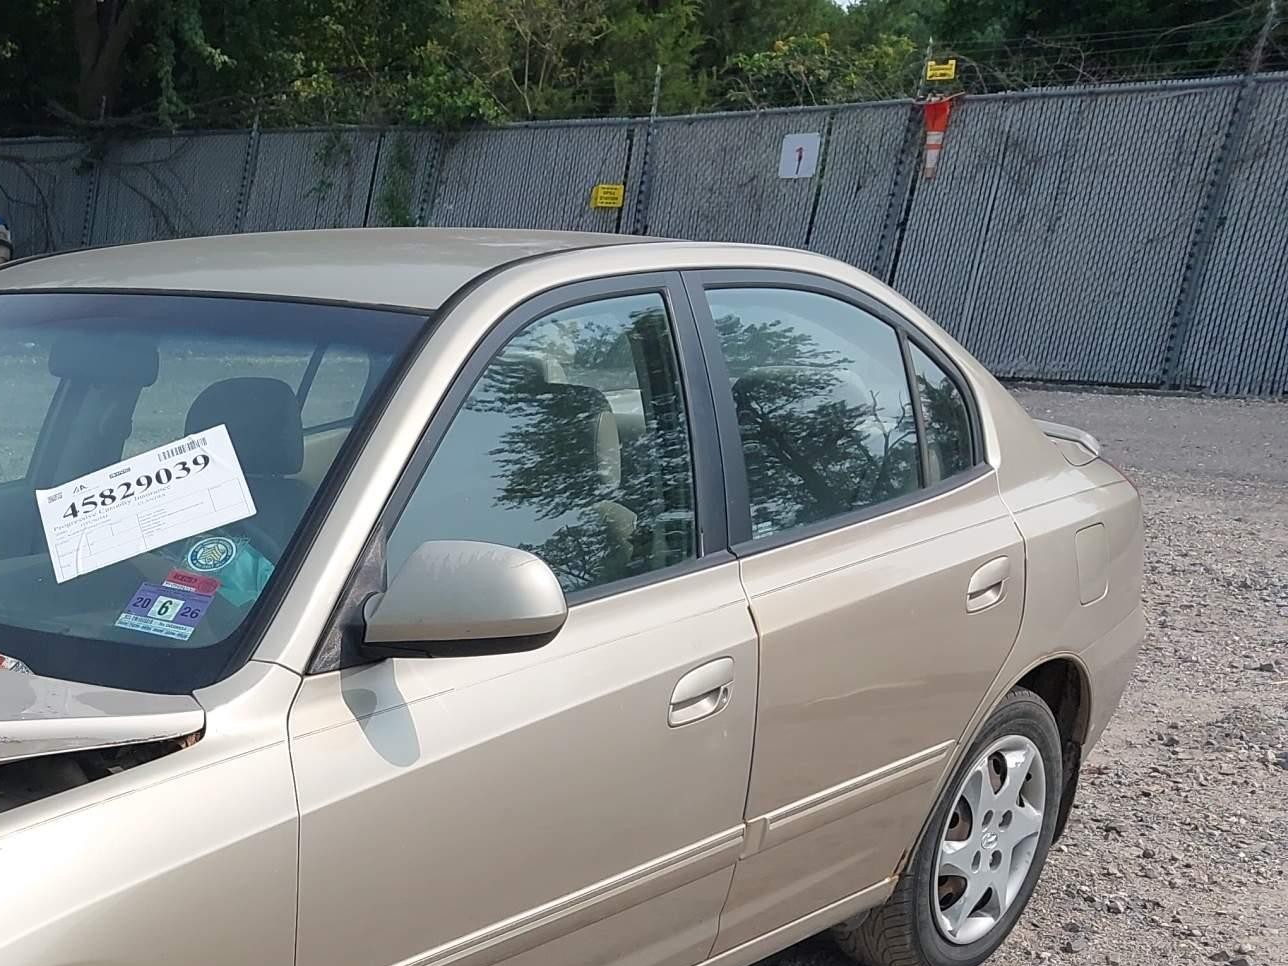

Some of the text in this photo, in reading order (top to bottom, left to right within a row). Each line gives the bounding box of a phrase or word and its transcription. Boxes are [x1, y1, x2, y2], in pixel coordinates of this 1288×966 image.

[62, 454, 210, 520] 45829039
[132, 597, 201, 619] 20 6 26
